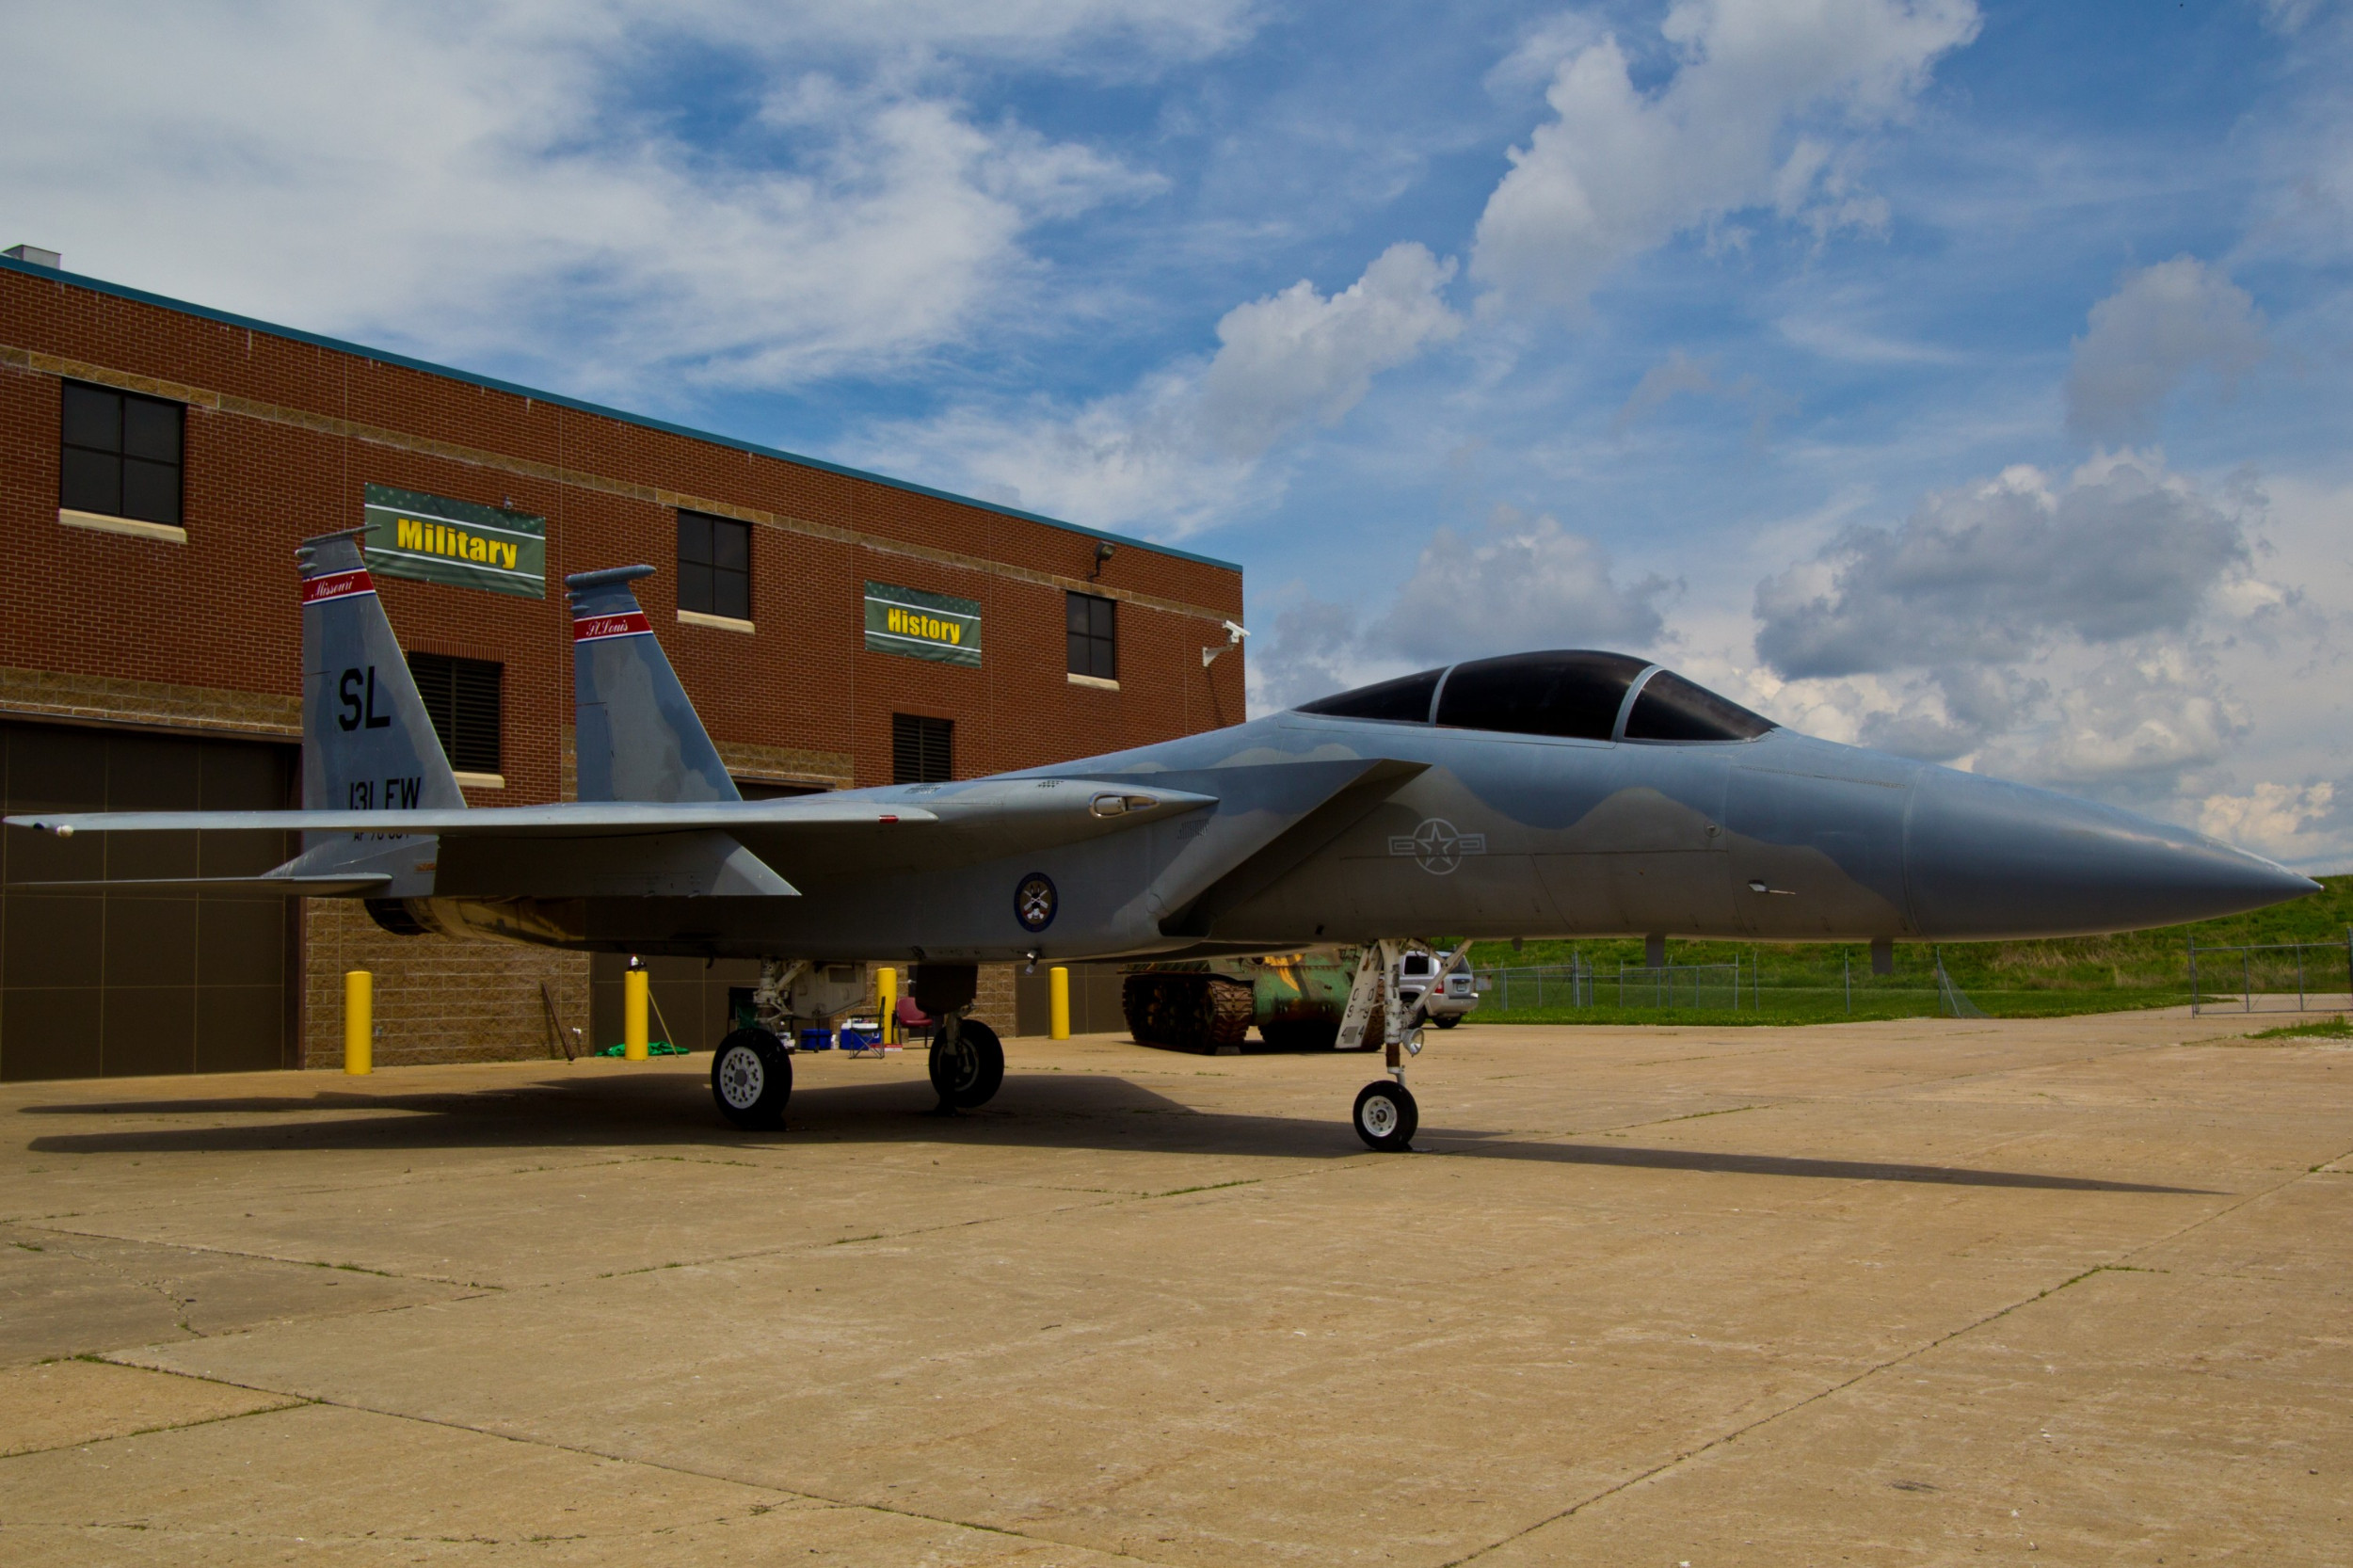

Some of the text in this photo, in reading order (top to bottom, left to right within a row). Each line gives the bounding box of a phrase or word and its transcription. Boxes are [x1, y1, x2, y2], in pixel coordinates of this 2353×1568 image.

[397, 518, 518, 569] Military
[311, 576, 355, 600] Missouri
[888, 607, 960, 645] History
[339, 665, 391, 732] SL
[350, 776, 422, 809] 131 FW
